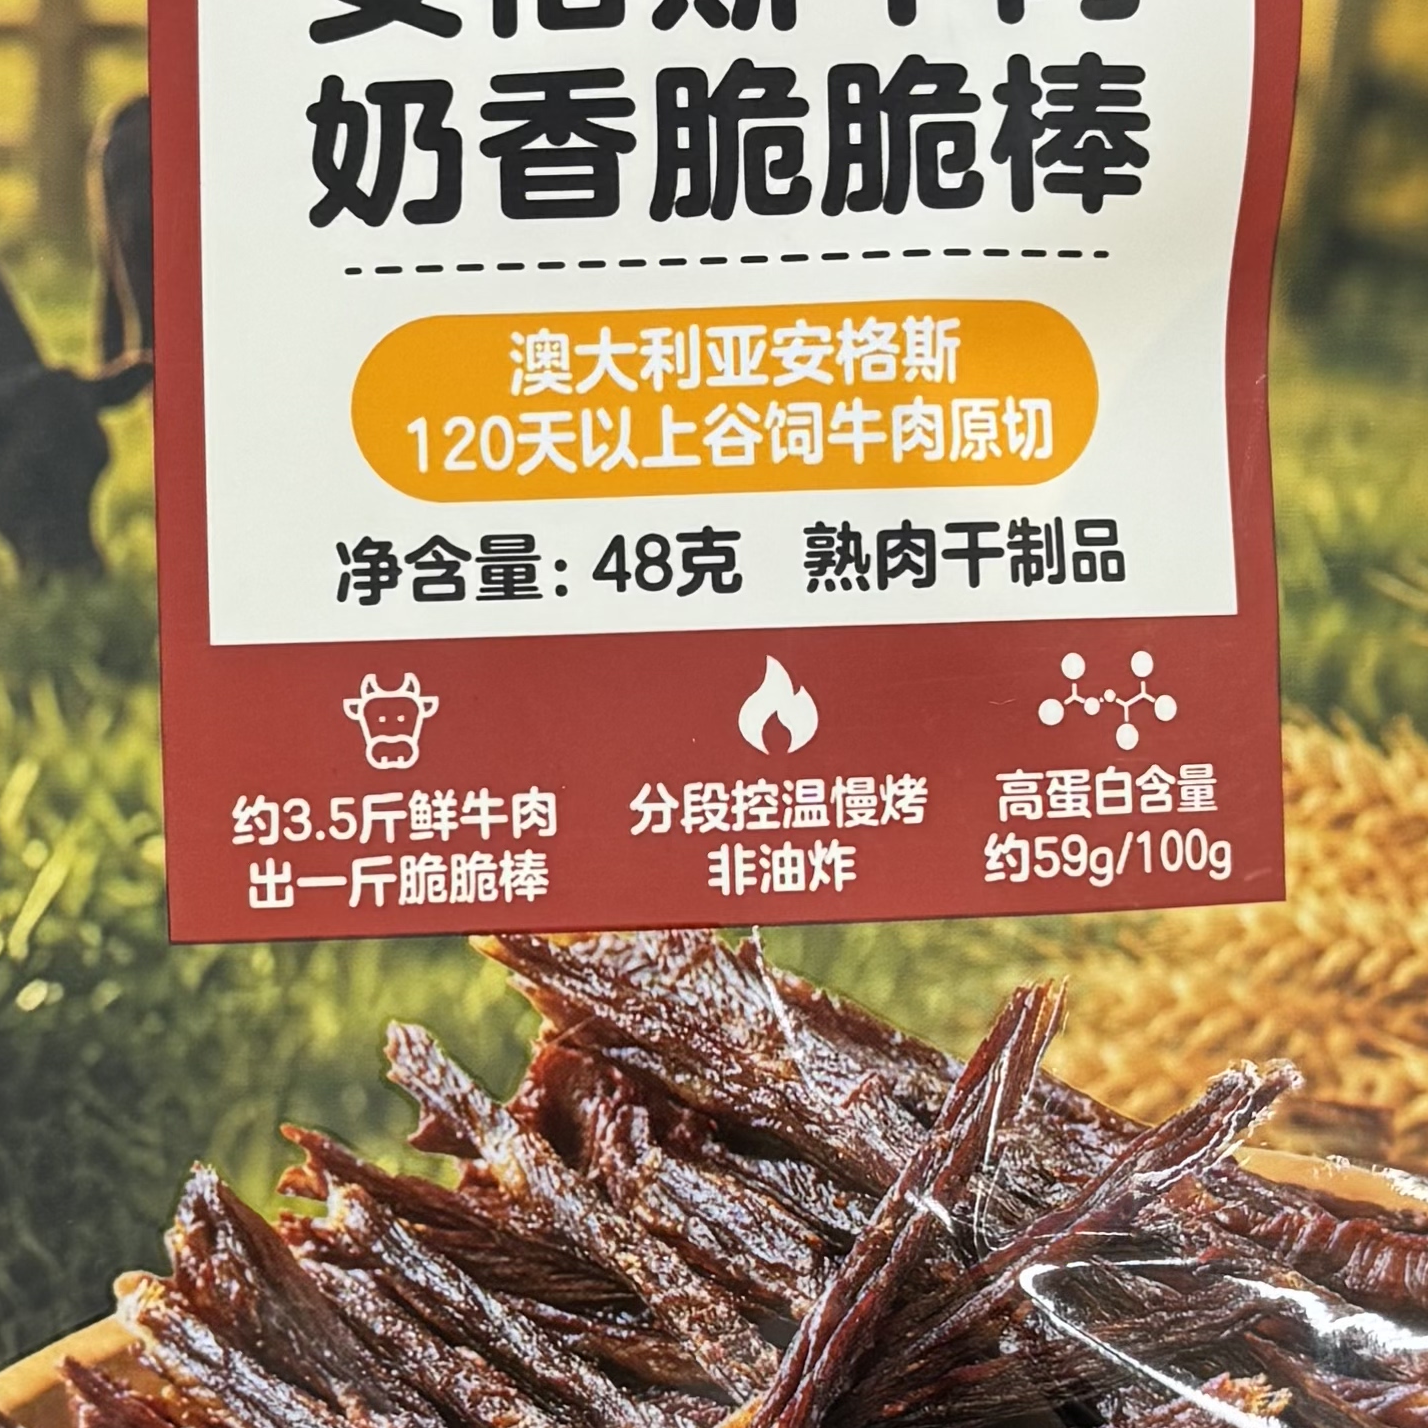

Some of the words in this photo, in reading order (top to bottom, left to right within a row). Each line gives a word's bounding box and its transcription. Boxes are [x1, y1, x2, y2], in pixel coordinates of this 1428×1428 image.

[304, 50, 1152, 229] 奶香脆脆棒
[509, 316, 961, 398] 澳大利亚安格斯
[406, 394, 1054, 479] 120天以上谷饲牛肉原切
[802, 515, 1127, 595] 熟肉干制品
[230, 784, 558, 847] 约3.5斤鲜牛肉
[628, 772, 930, 837] 分段控温慢烤
[994, 762, 1219, 823] 高蛋白含量
[247, 847, 551, 910] 出一斤脆脆棒
[706, 837, 858, 897] 非油炸
[982, 827, 1233, 889] 约59g/100g
